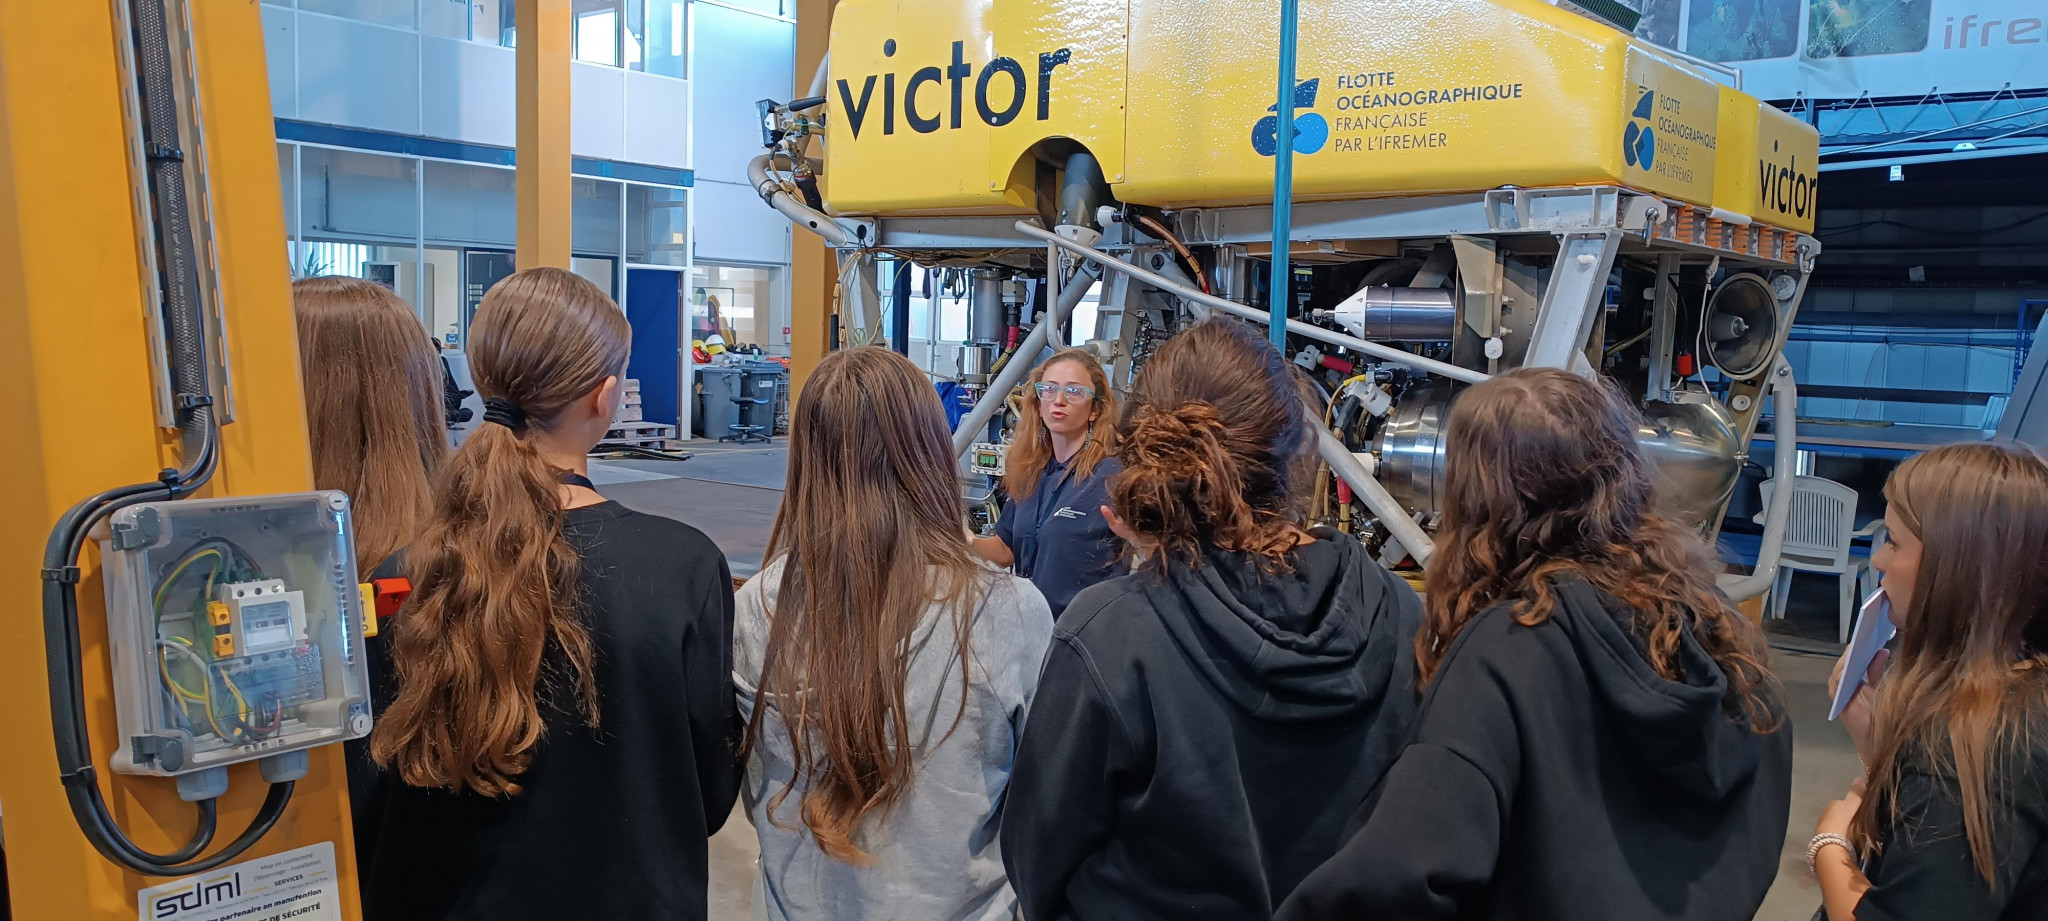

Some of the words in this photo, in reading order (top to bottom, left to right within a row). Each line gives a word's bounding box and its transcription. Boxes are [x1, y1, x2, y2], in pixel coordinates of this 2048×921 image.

[1944, 15, 2048, 49] ifre
[836, 38, 1072, 142] victor
[1337, 72, 1395, 89] FLOTTE
[1336, 83, 1523, 111] OCÉANOGRAPHIQUE
[1660, 94, 1681, 115] FLOTTE
[1335, 112, 1428, 132] FRANÇAISE
[1658, 115, 1716, 150] OCÉANOGRAPHIQUE
[1335, 137, 1362, 152] PAR
[1368, 132, 1447, 151] L'IFREMER
[1657, 138, 1688, 161] FRANÇAISE
[1656, 160, 1666, 175] PAR
[1759, 139, 1817, 220] victor
[290, 860, 322, 871] Installation
[274, 874, 304, 887] SERVICES
[156, 872, 241, 918] sdml
[220, 906, 262, 921] partenaire
[273, 889, 322, 907] manutention
[281, 901, 321, 920] SÉCURITÉ
